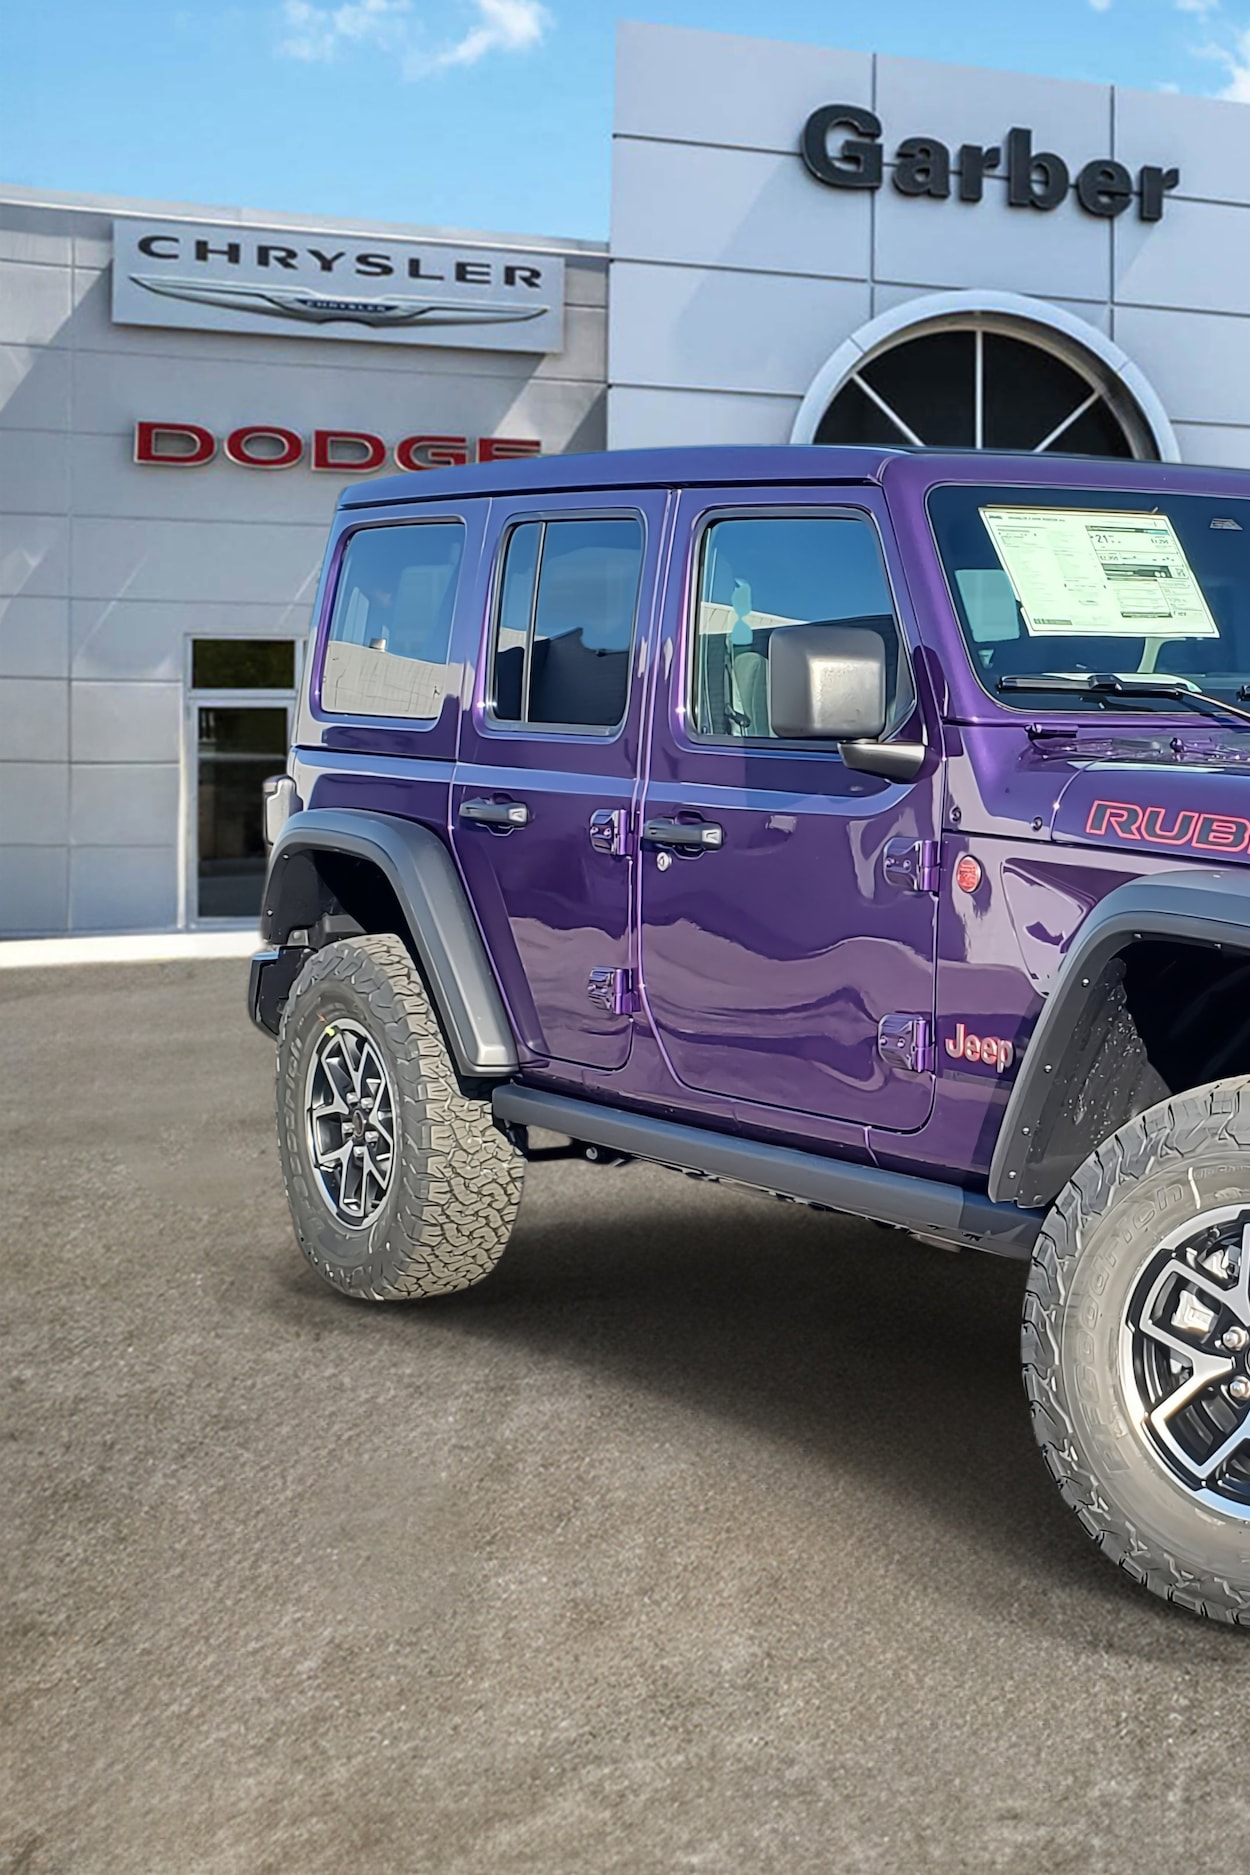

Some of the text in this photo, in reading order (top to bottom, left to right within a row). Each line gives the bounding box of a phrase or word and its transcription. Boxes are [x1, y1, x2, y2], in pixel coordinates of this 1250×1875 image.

[801, 104, 1180, 223] Garber
[137, 234, 543, 288] CHRYSLER
[305, 300, 387, 313] CHRYSLER
[133, 421, 543, 474] DODGE
[945, 1023, 1015, 1074] Jeep
